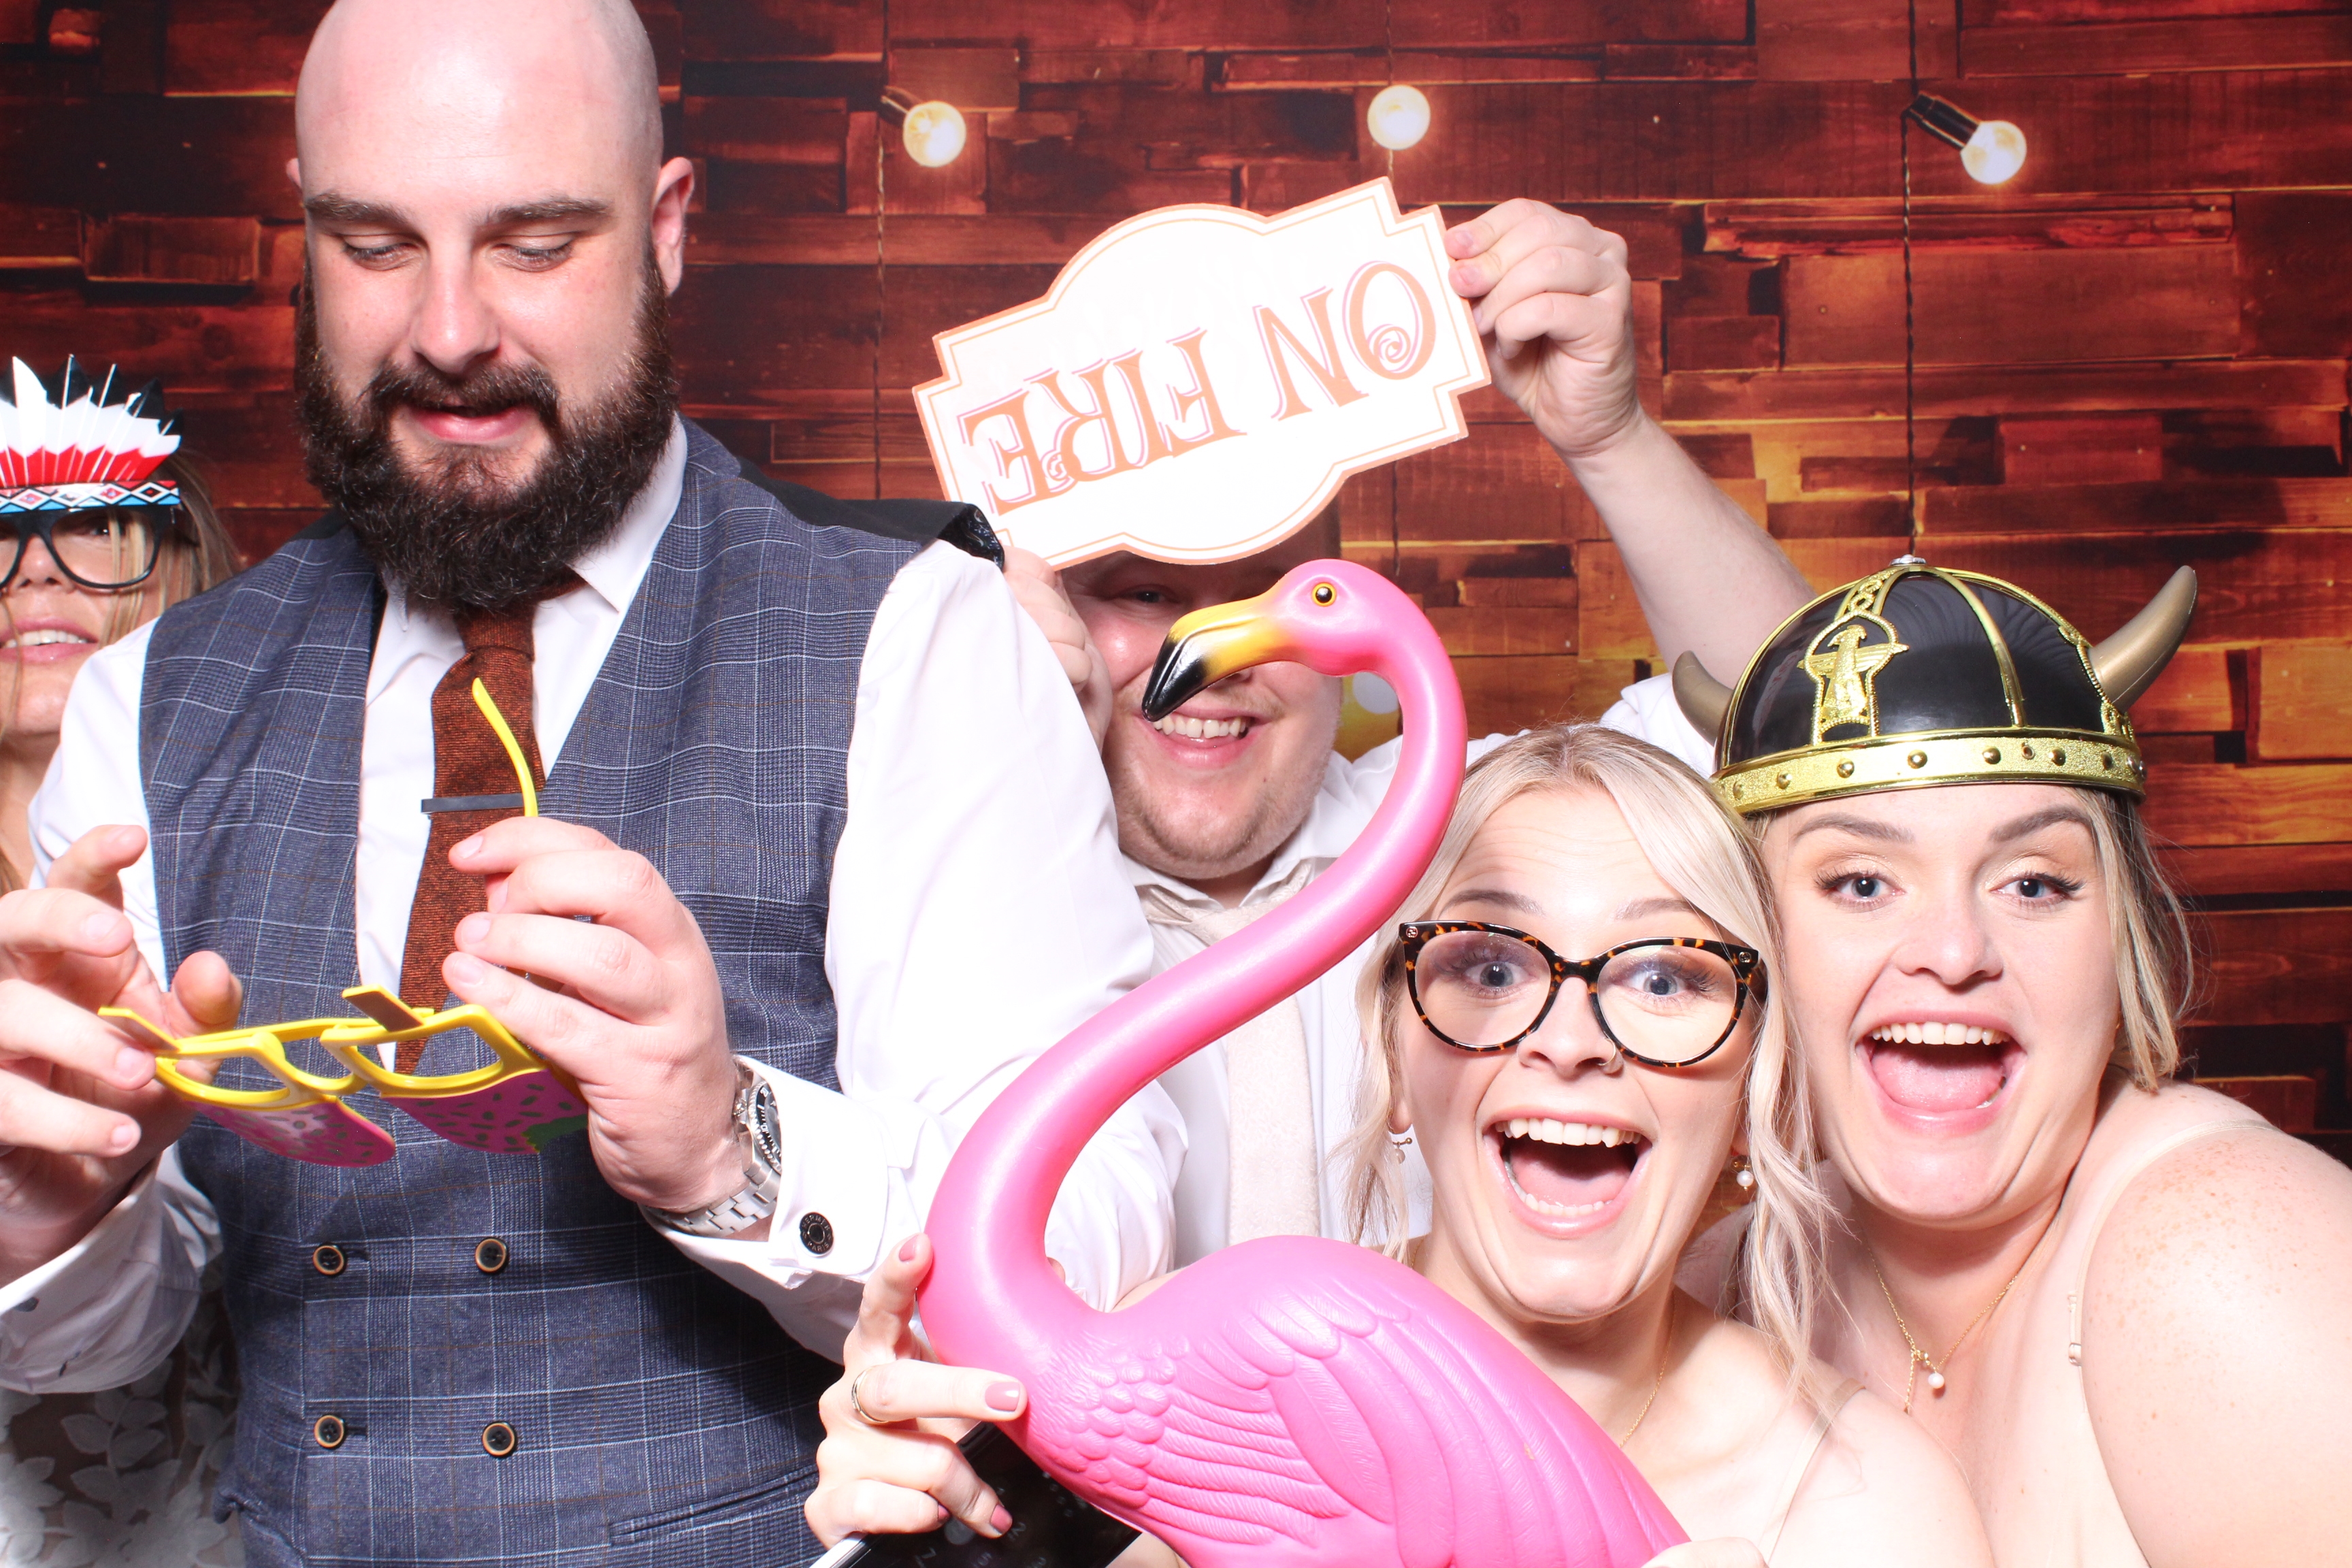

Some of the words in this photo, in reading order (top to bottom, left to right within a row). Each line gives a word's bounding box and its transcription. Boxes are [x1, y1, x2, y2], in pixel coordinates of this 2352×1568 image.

[1252, 261, 1437, 421] ON
[957, 327, 1247, 517] FIRE
[807, 1241, 830, 1252] PARIS
[1011, 1522, 1027, 1536] 2
[921, 1547, 937, 1559] 7
